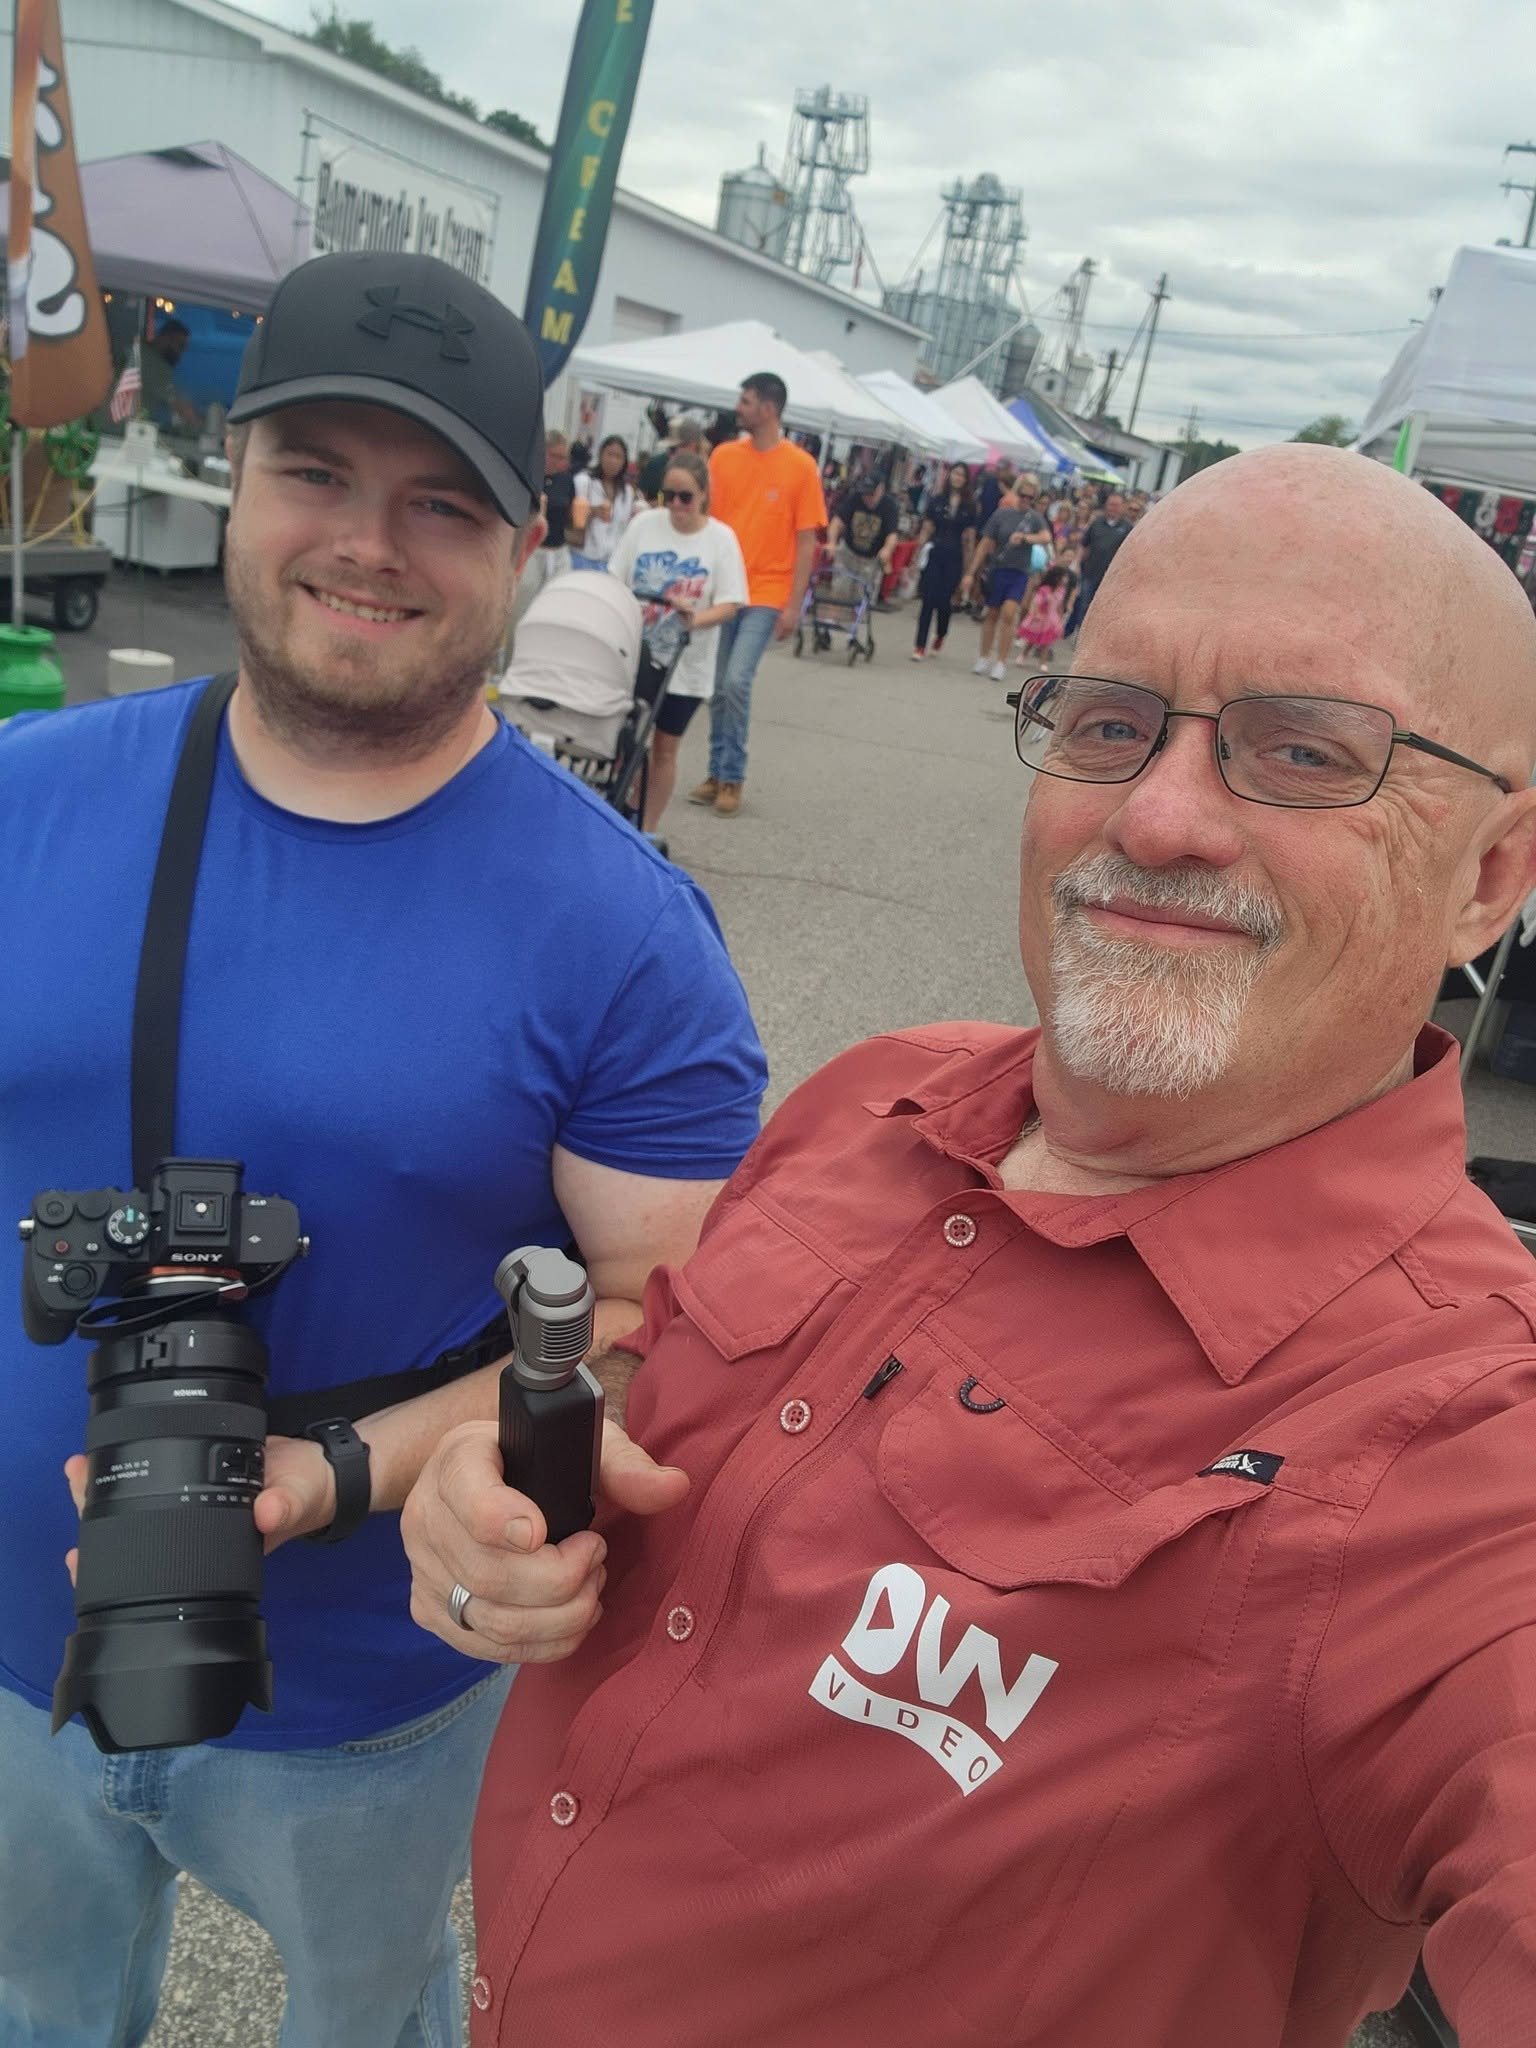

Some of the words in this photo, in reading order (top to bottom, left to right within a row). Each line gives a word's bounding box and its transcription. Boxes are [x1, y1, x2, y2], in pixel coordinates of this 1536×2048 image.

[171, 1252, 223, 1263] SONY
[841, 1563, 1060, 1743] DW
[828, 1671, 989, 1783] VIDEO
